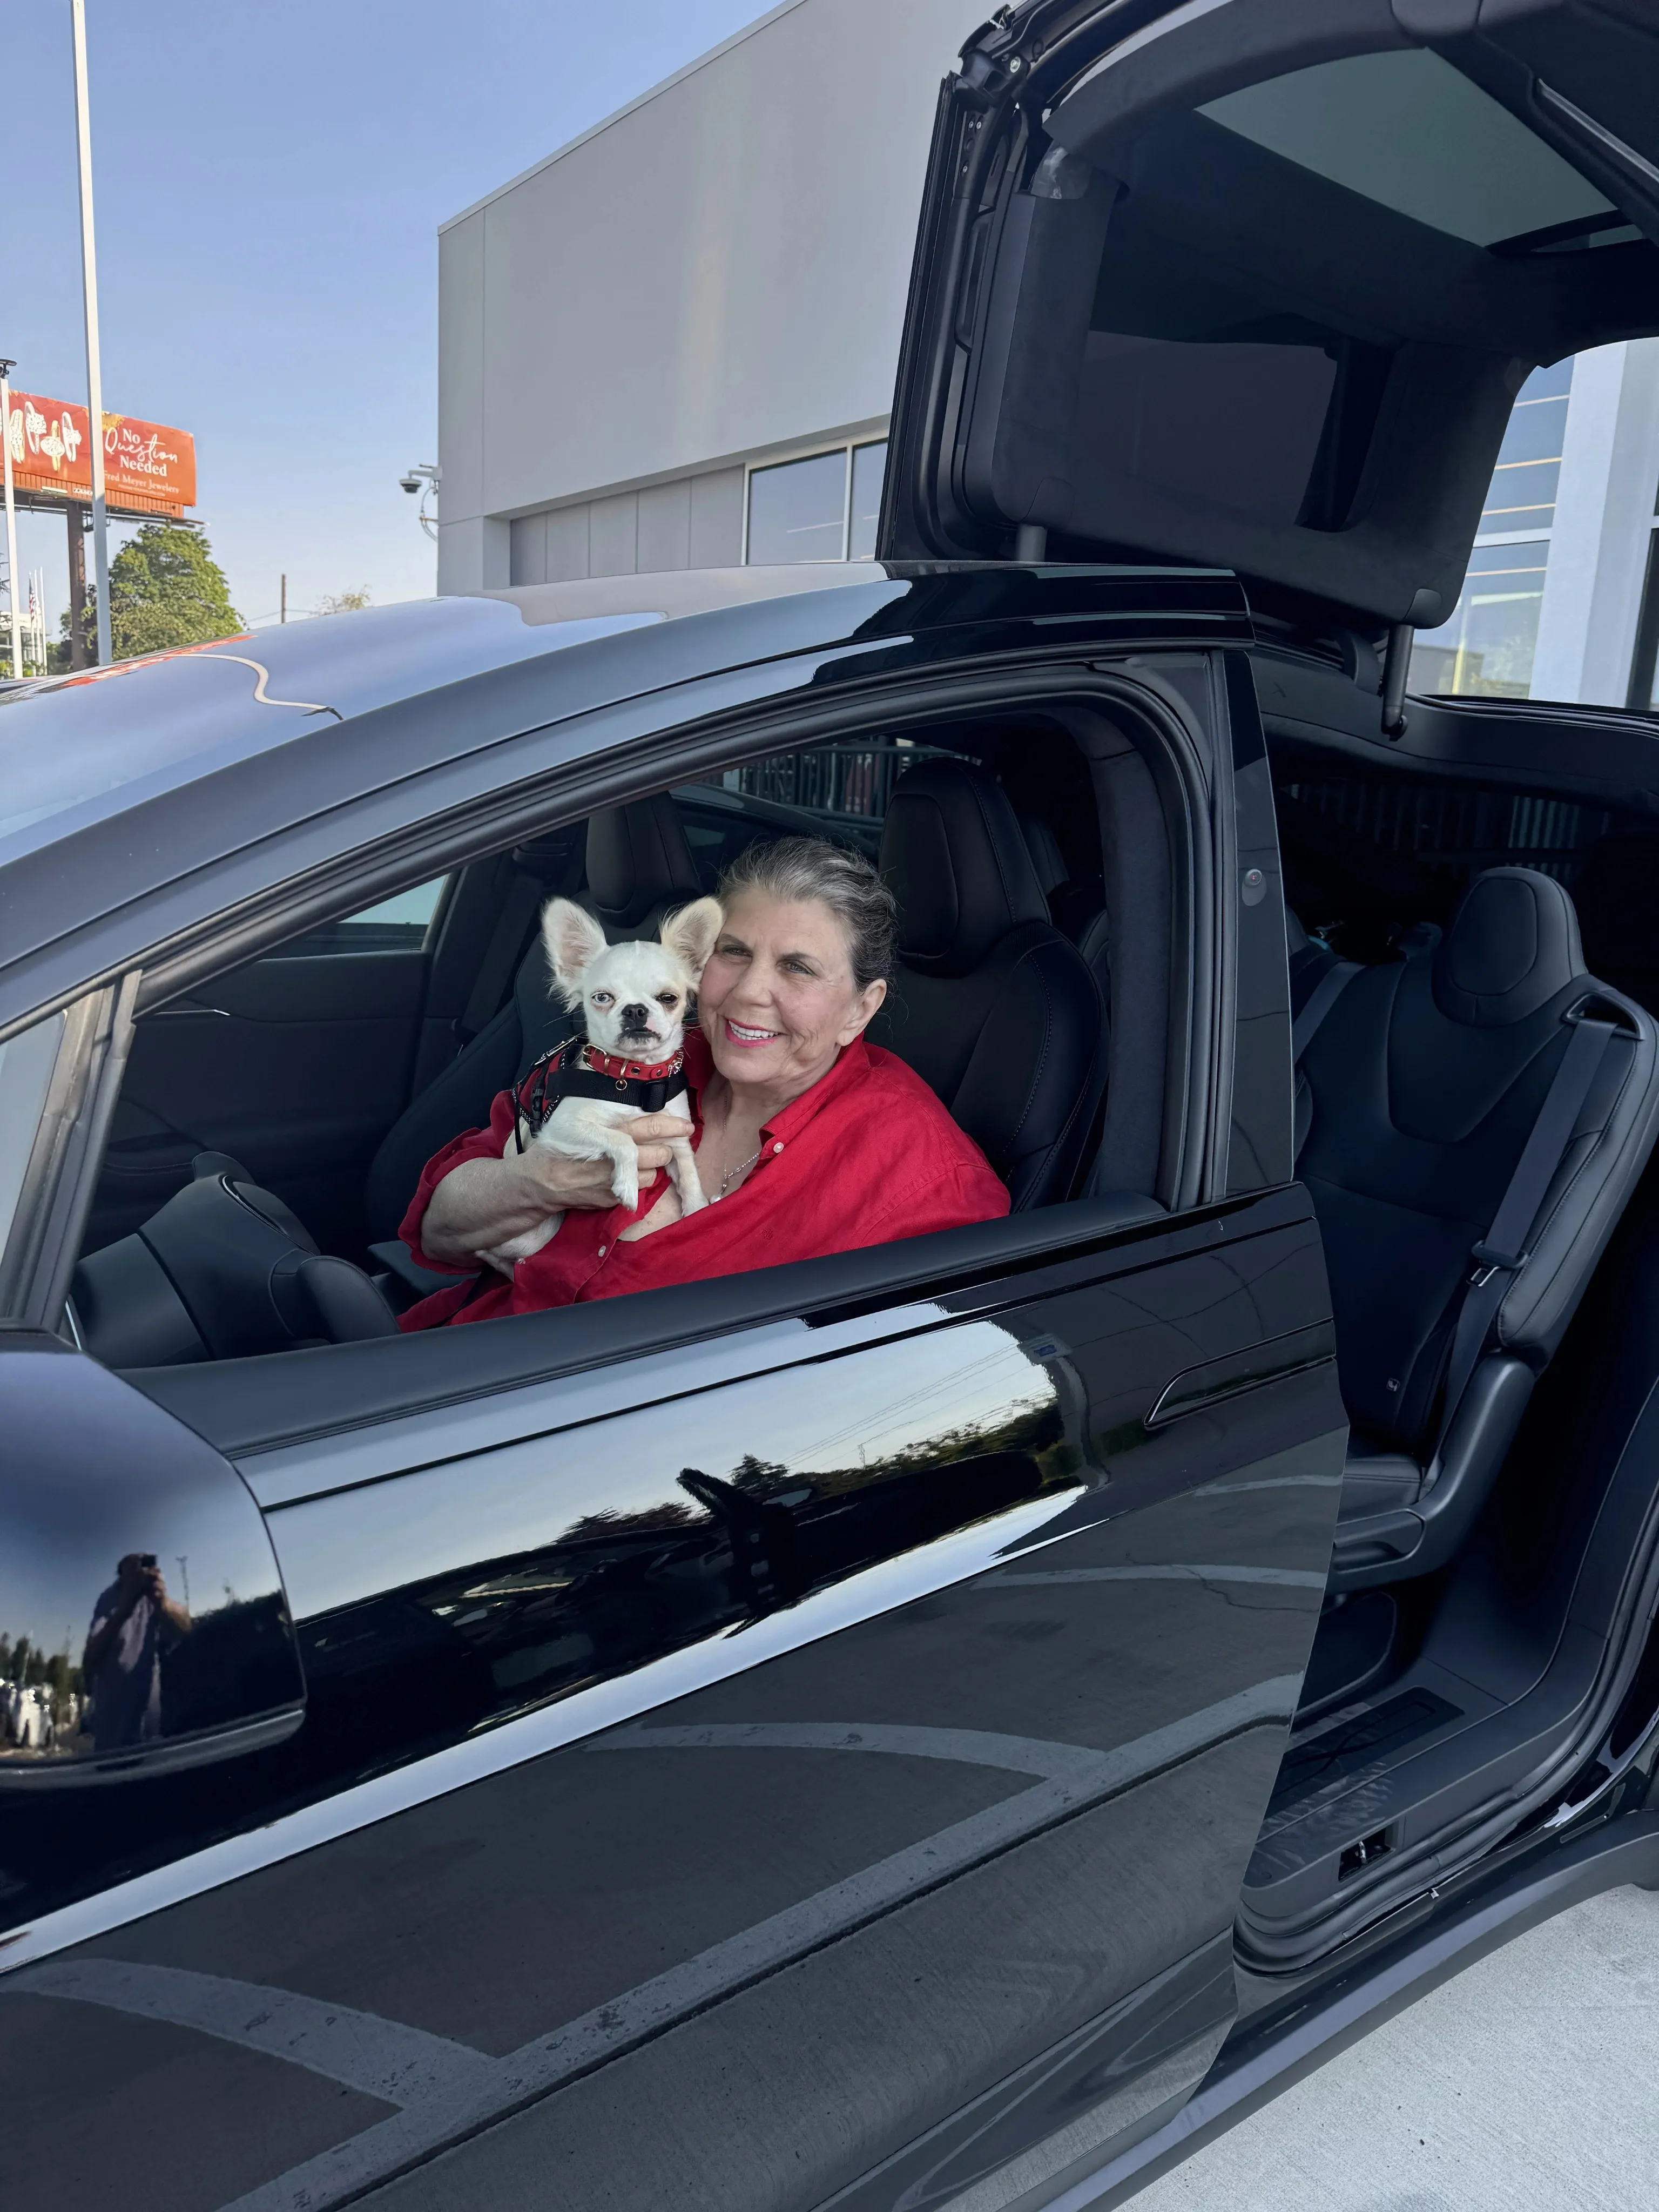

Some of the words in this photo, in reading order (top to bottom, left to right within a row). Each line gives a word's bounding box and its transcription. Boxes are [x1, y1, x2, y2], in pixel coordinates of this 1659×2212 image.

[105, 427, 178, 464] Question
[123, 428, 140, 444] No
[120, 455, 167, 477] Needed
